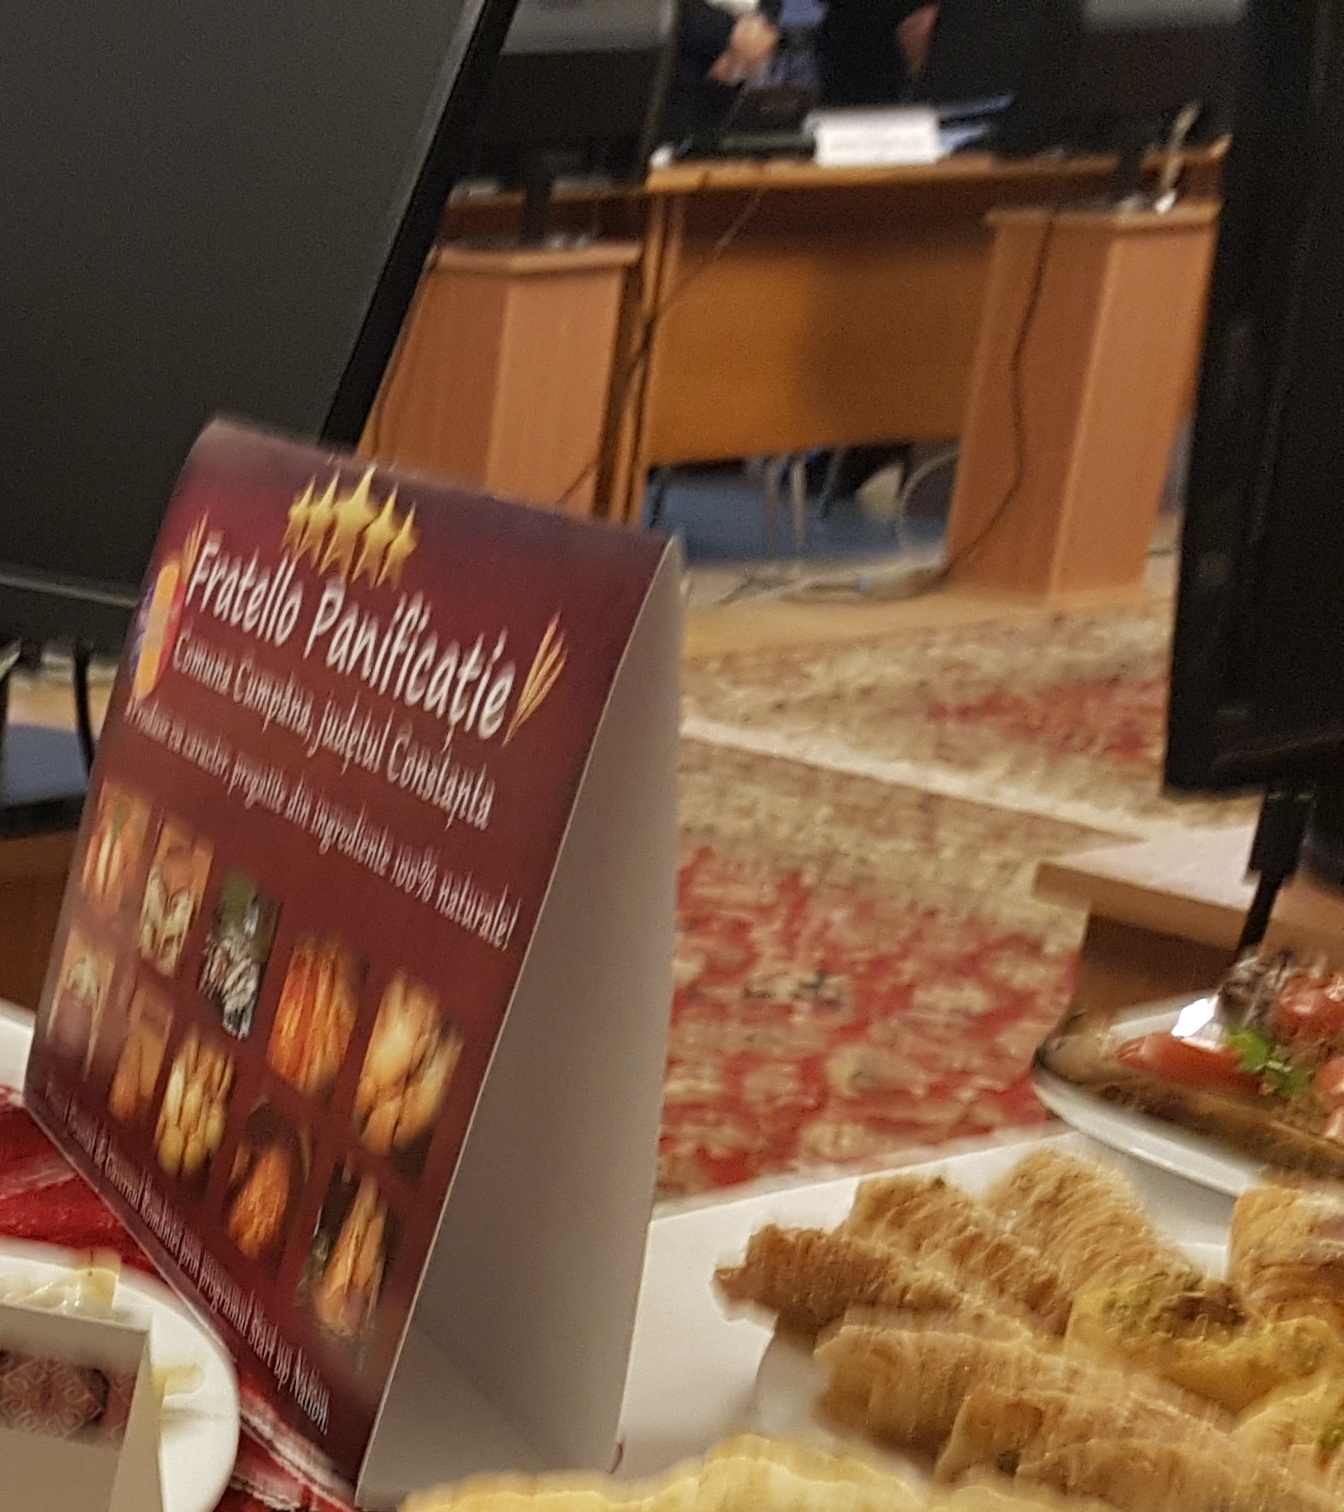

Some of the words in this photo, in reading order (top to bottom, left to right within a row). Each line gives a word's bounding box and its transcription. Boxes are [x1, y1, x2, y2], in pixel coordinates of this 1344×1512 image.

[184, 533, 305, 648] Fratello
[173, 622, 234, 696] Comuna
[390, 848, 439, 903] 100%
